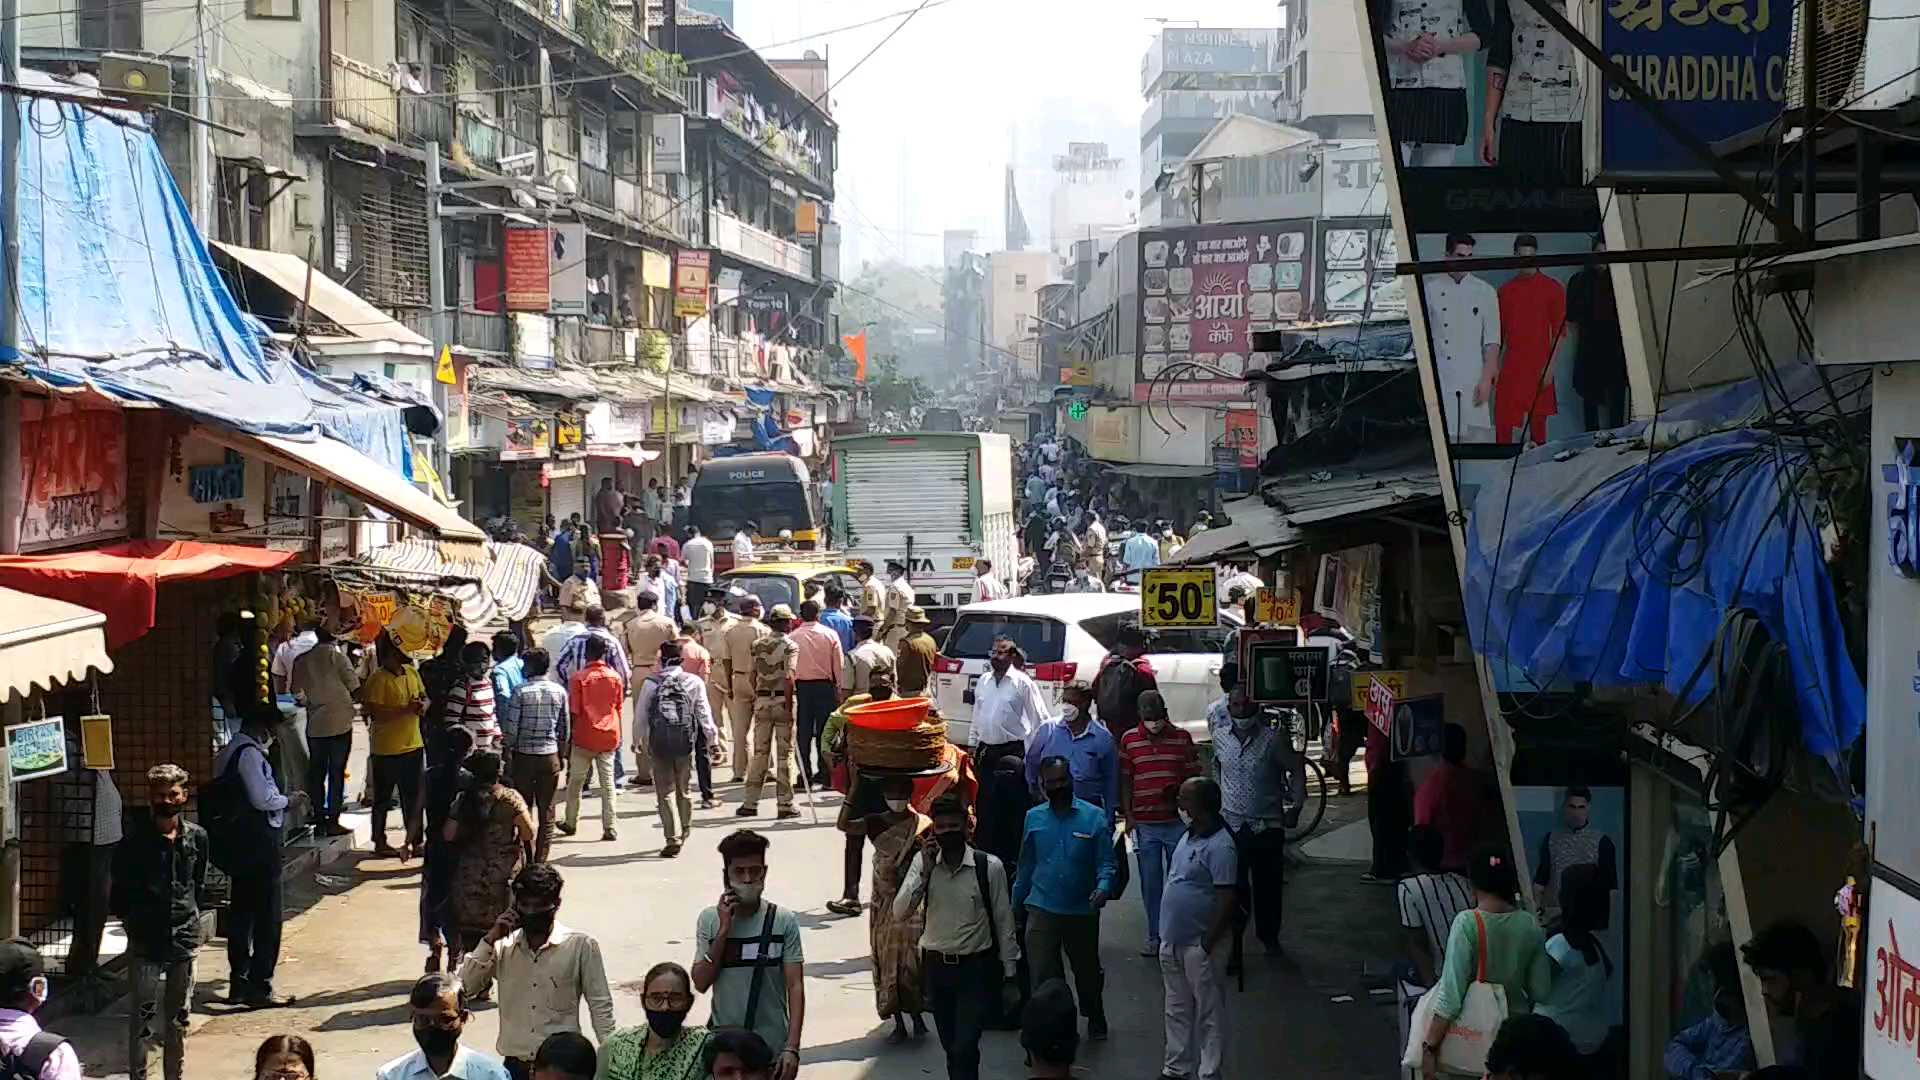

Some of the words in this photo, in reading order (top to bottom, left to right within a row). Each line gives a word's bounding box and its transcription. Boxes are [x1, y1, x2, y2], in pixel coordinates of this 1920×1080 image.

[1608, 54, 1759, 102] SHRADDHA
[1195, 280, 1247, 320] आर्या
[729, 470, 765, 480] POLICE
[1157, 582, 1203, 620] 50
